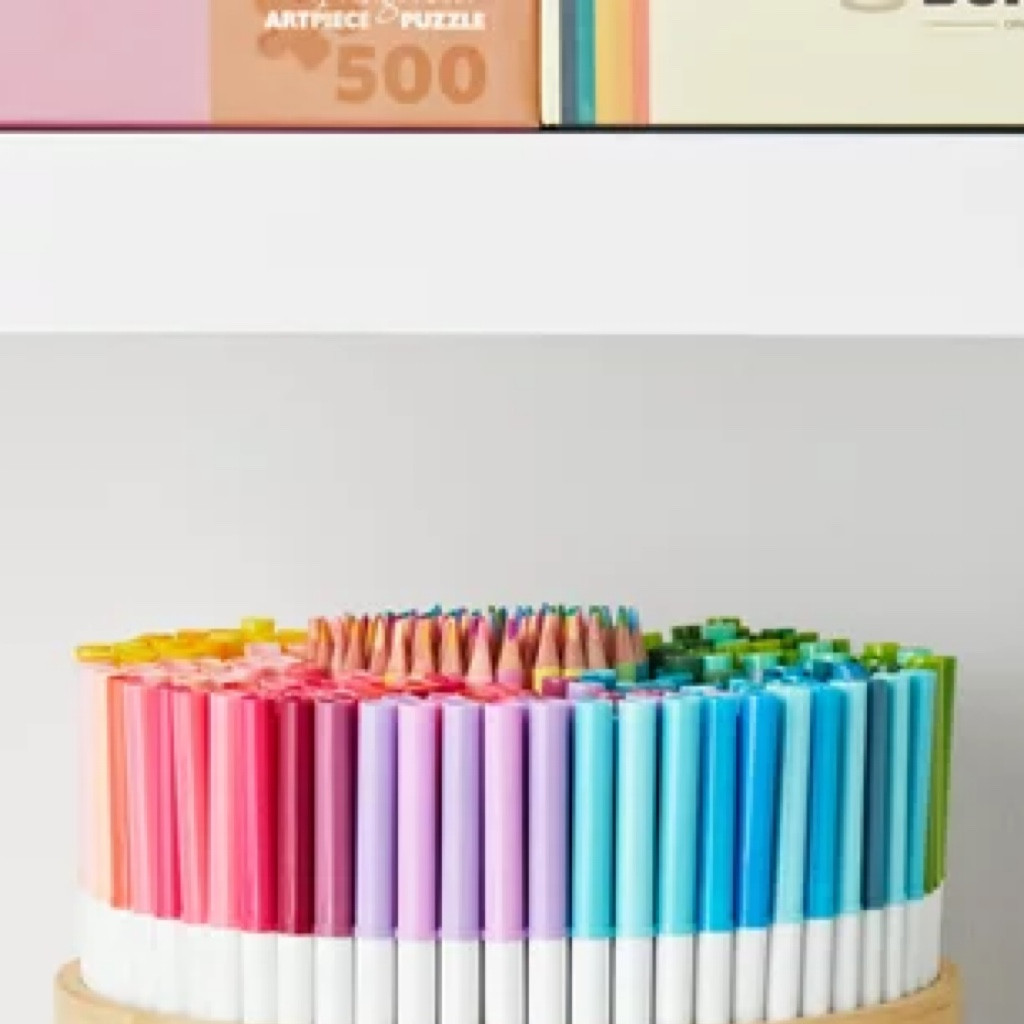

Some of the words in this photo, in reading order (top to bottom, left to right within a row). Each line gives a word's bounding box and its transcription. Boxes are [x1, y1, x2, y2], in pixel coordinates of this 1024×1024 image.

[264, 10, 369, 29] ARTPIECE
[401, 10, 486, 30] PUZZLE
[335, 44, 487, 105] 500
